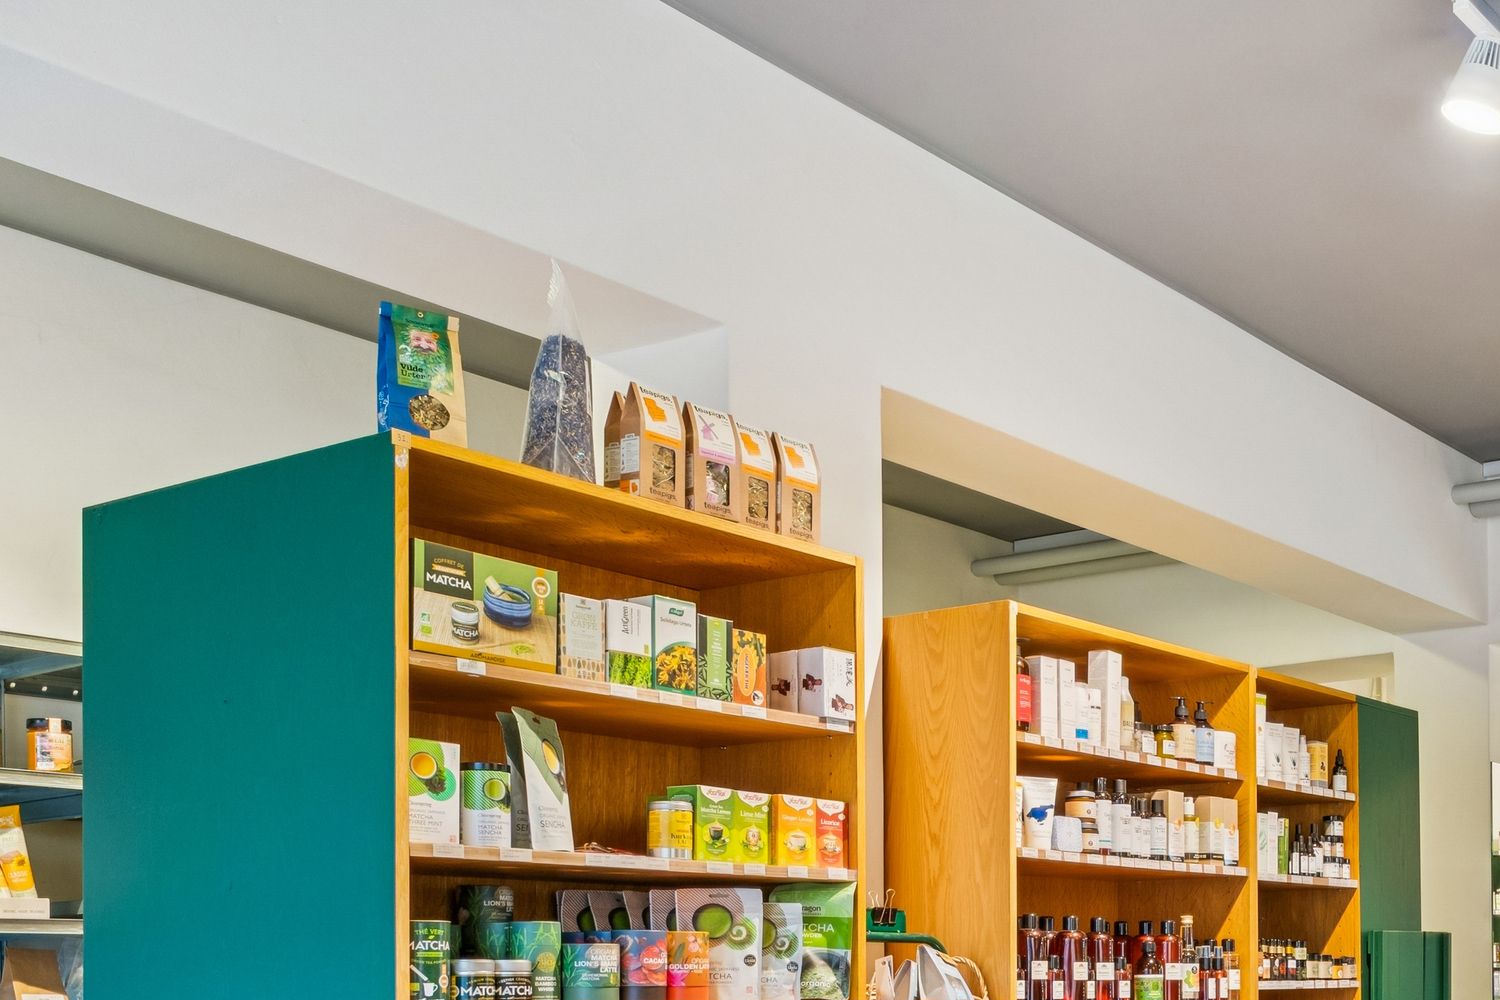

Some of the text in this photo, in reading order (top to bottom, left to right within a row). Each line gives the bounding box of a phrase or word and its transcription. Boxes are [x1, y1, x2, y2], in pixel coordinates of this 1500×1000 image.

[400, 362, 424, 373] Vilde
[434, 557, 456, 566] COFFRET
[426, 571, 472, 591] MATCHA
[540, 820, 566, 829] SENCHA
